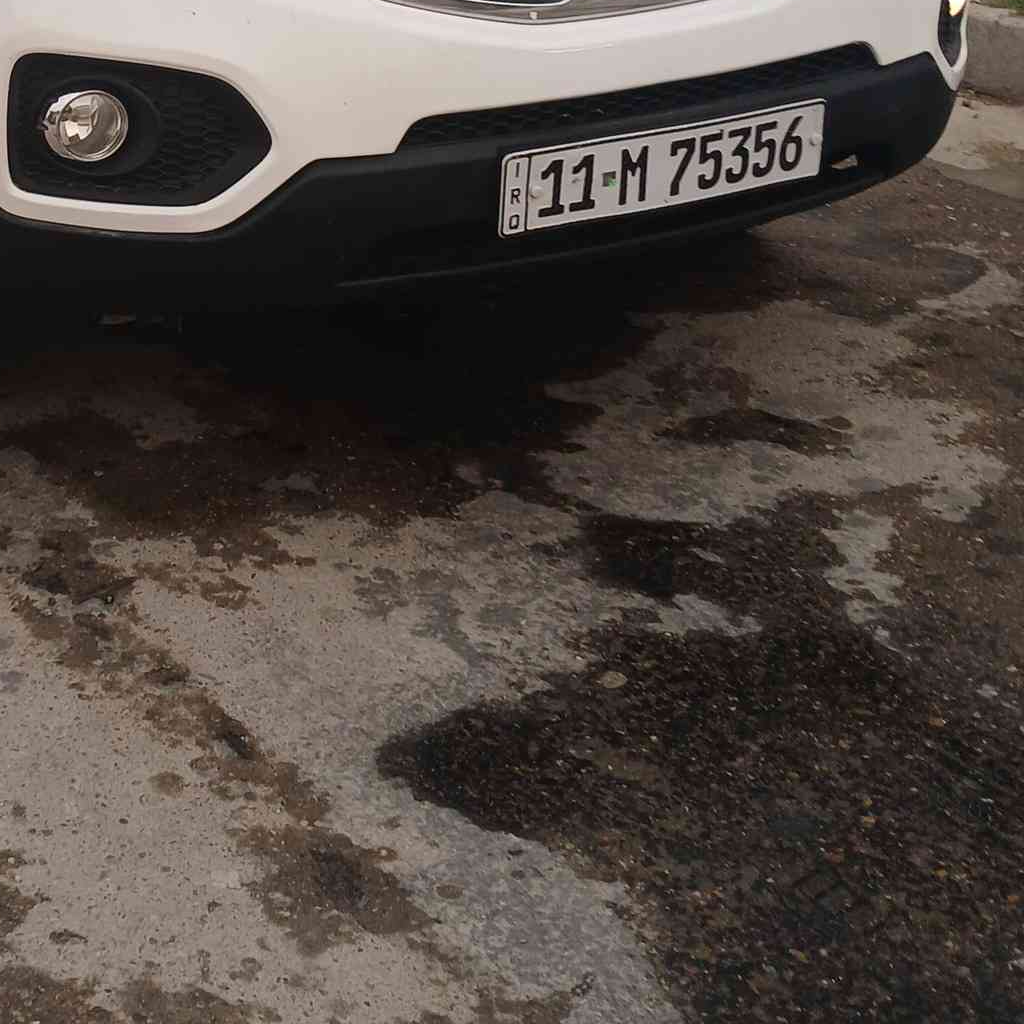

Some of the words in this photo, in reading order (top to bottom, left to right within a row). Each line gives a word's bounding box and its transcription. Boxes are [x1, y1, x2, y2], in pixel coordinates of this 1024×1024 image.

[538, 154, 595, 218] 11
[618, 145, 649, 206] M
[669, 115, 804, 197] 75356
